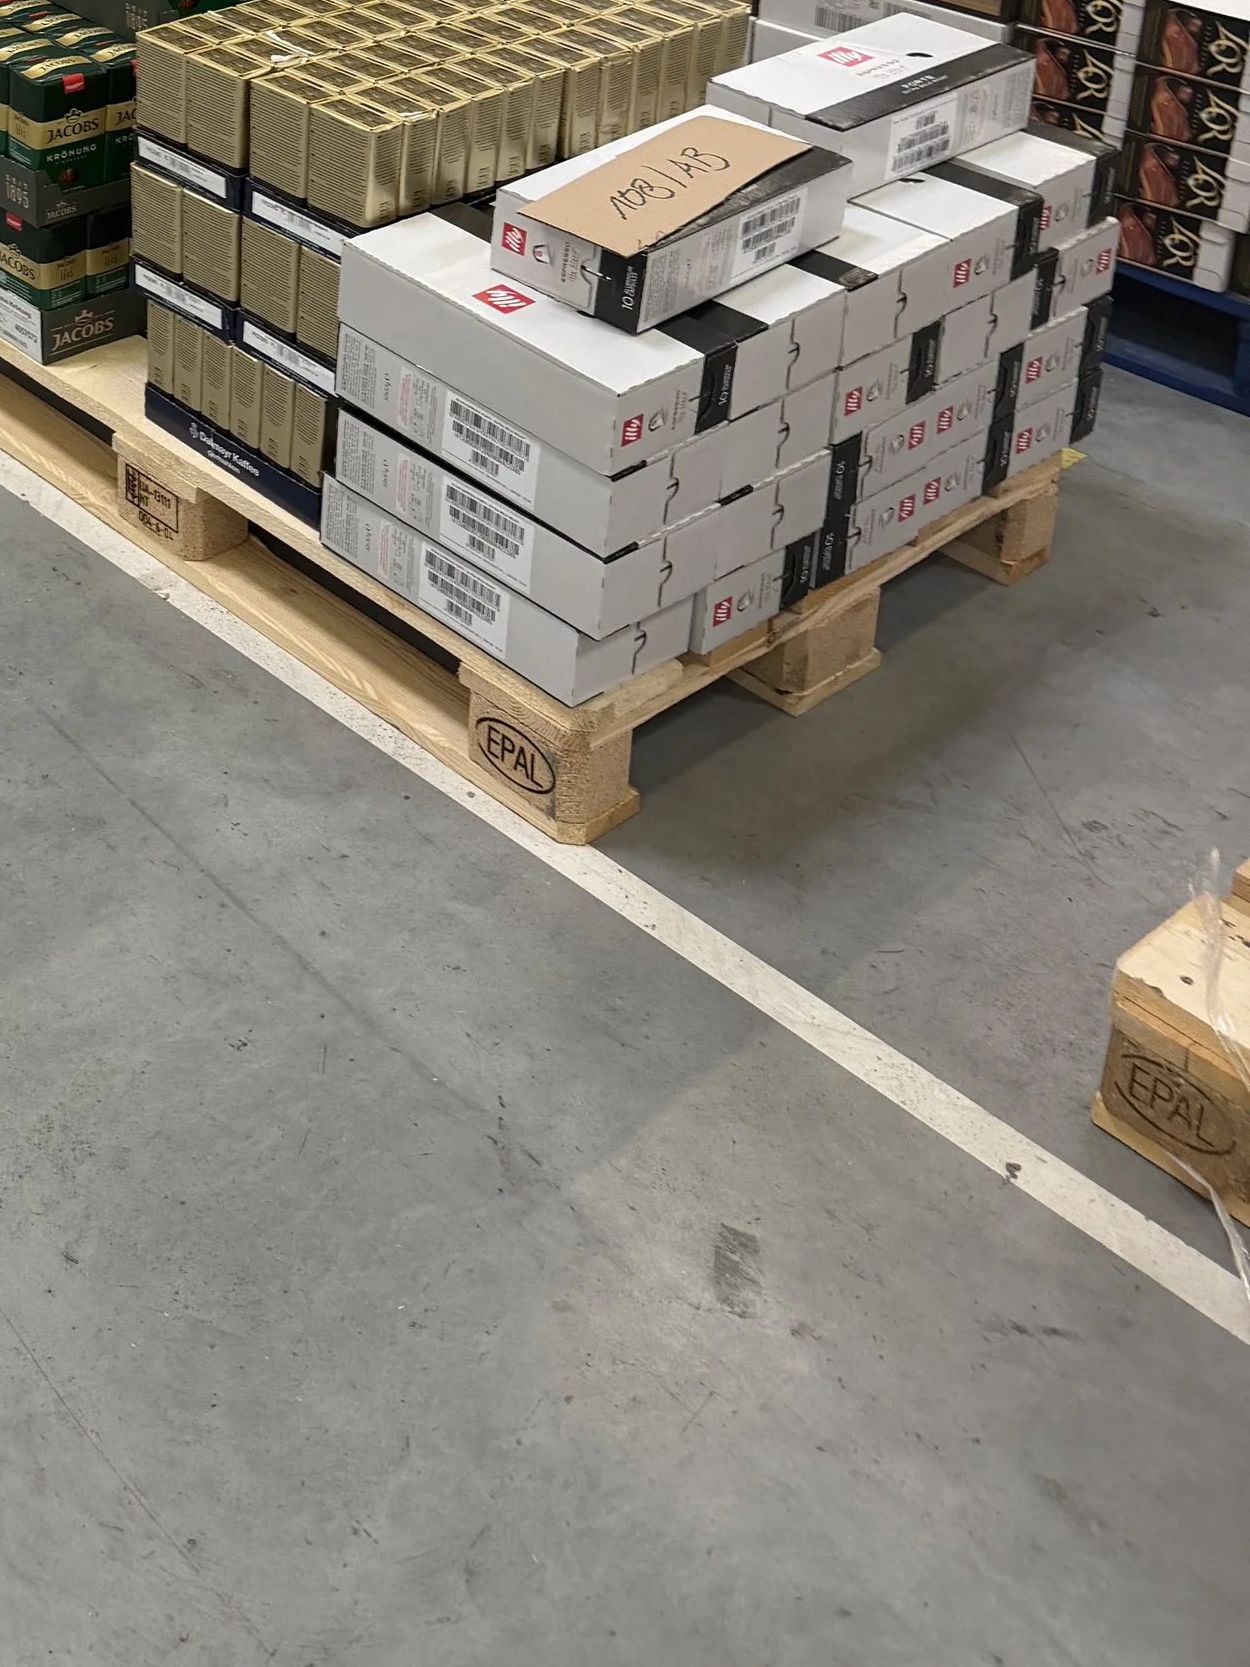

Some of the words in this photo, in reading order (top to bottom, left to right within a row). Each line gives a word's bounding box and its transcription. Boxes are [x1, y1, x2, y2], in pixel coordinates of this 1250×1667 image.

[828, 49, 863, 65] illy
[115, 108, 137, 125] JAC
[47, 118, 99, 144] JACOBS
[46, 142, 97, 163] KRÖNUNG
[6, 184, 29, 209] 1895
[46, 205, 77, 221] JACOBS
[504, 225, 524, 253] illy
[954, 261, 970, 284] illy
[486, 288, 527, 308] illy
[621, 294, 634, 311] 10
[51, 317, 114, 352] JACOBS
[1026, 359, 1042, 381] illy
[847, 390, 861, 411] illy
[624, 417, 643, 441] illy
[939, 409, 953, 431] illy
[1016, 430, 1032, 451] illy
[924, 480, 940, 502] illy
[715, 599, 732, 623] illy
[487, 725, 543, 789] EPAL
[1129, 1062, 1215, 1147] EPAL
